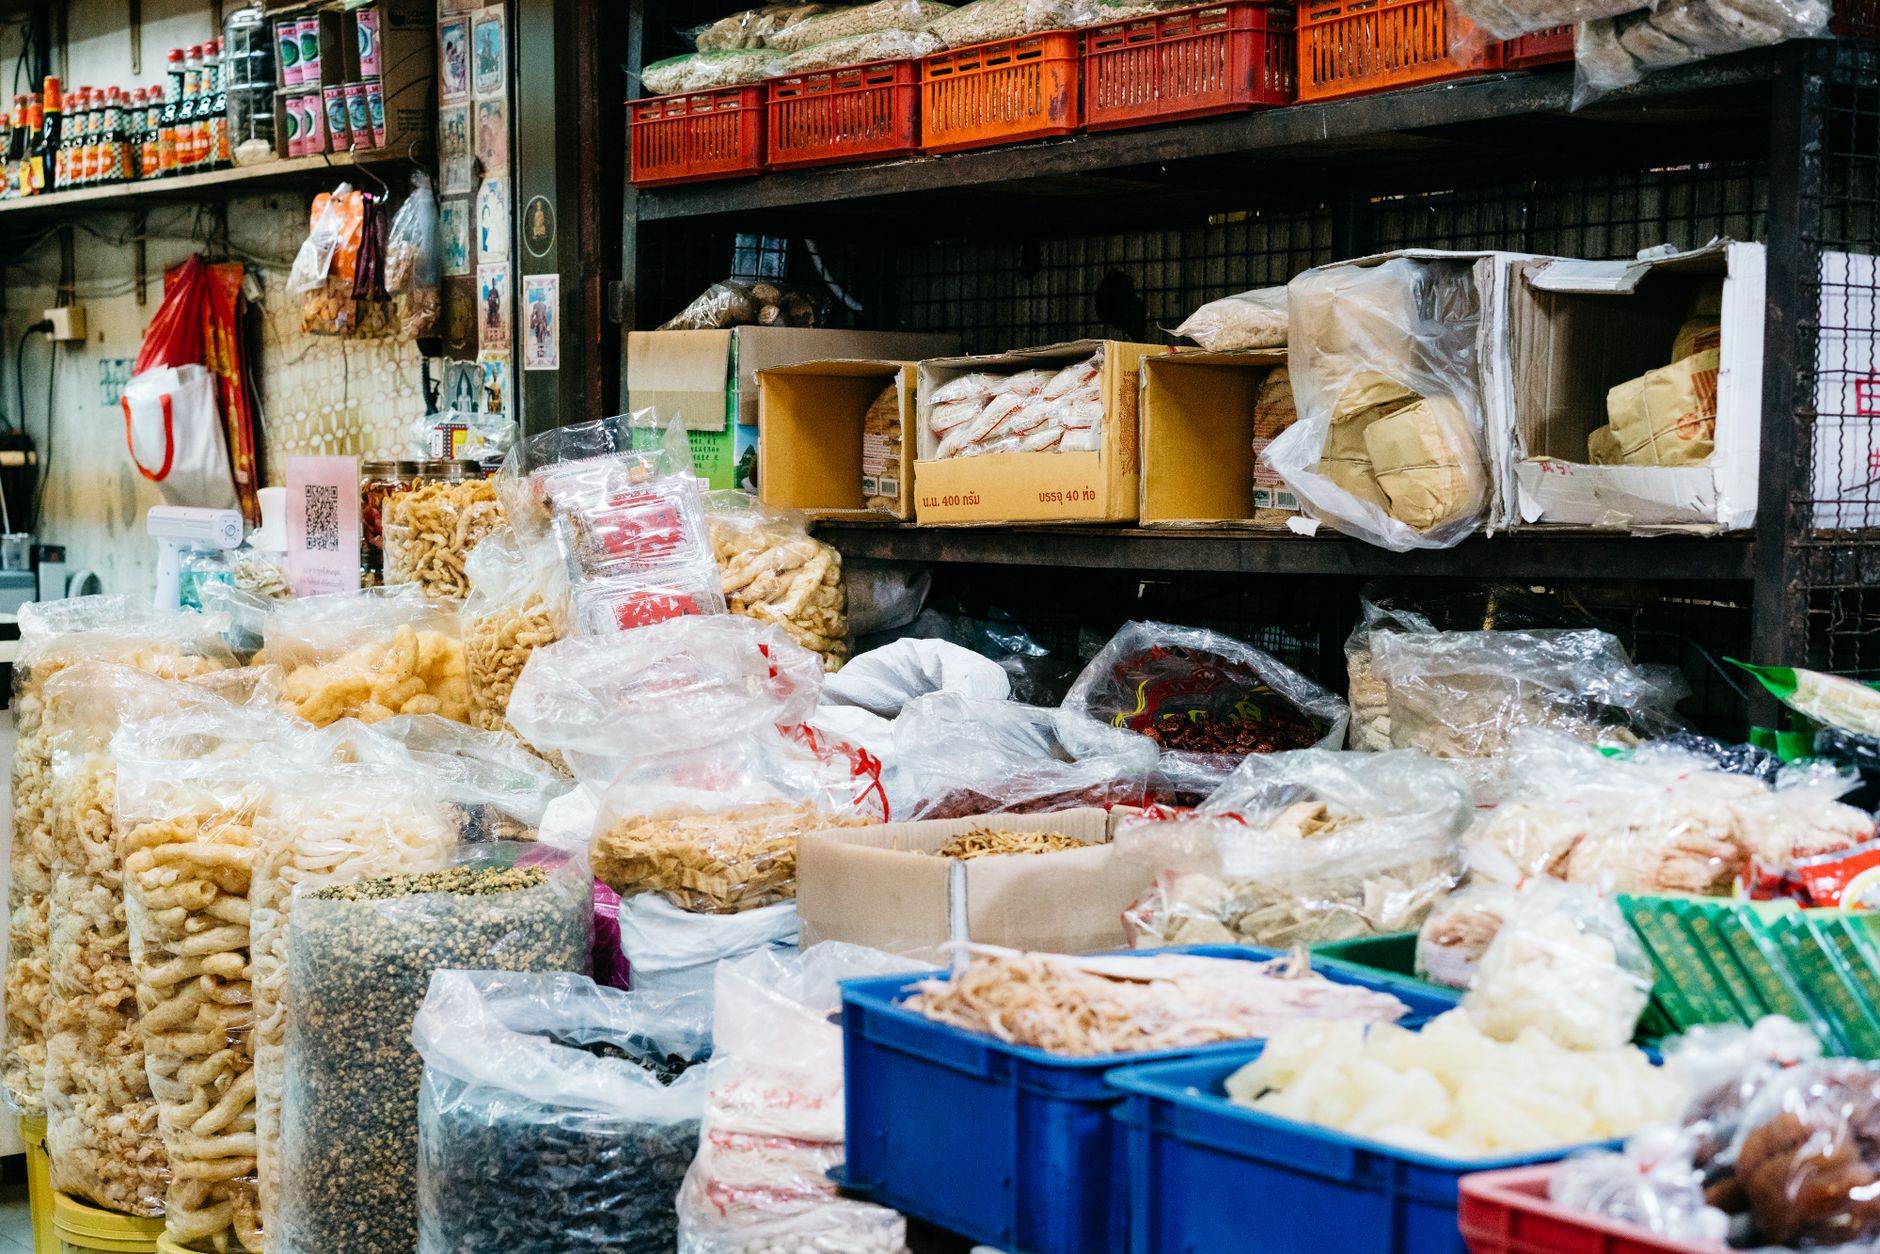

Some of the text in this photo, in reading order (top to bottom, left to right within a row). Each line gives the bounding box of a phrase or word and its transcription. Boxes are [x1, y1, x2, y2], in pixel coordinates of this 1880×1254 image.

[942, 495, 960, 506] 400
[963, 490, 980, 506] กรัม
[1039, 485, 1096, 506] บรรจุ 40 ห่อ
